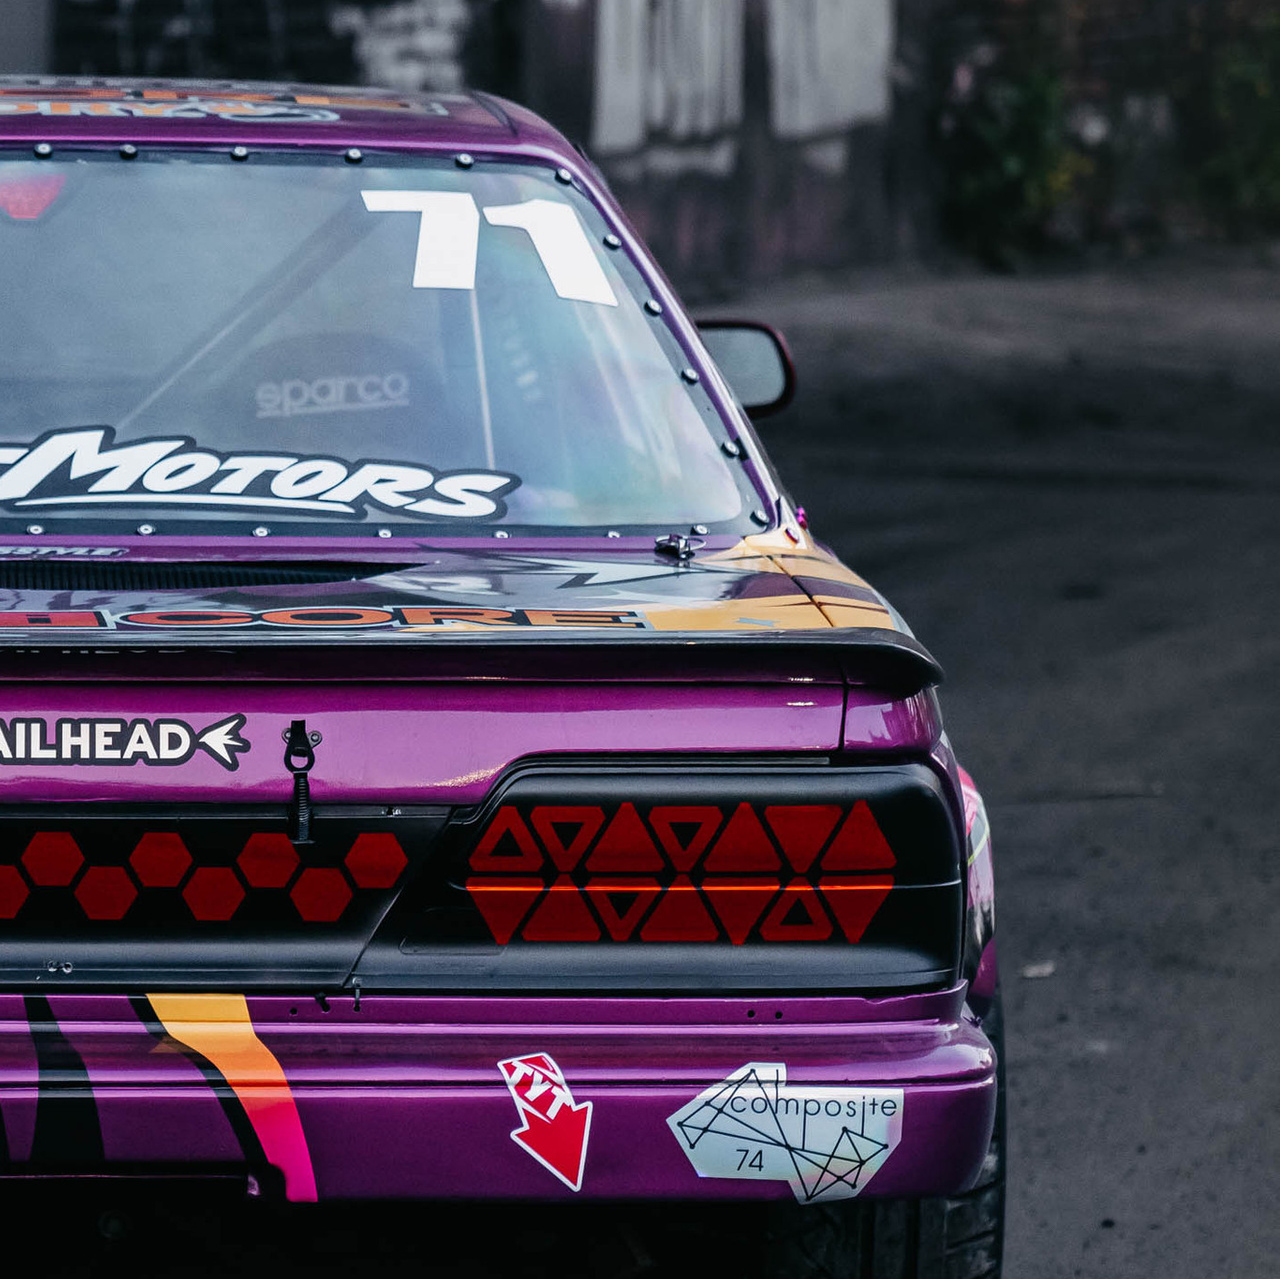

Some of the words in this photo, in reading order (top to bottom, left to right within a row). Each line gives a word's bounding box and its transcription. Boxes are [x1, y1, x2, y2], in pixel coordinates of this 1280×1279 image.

[256, 373, 410, 415] sparco
[731, 1093, 897, 1134] composite
[736, 1149, 764, 1172] 74
